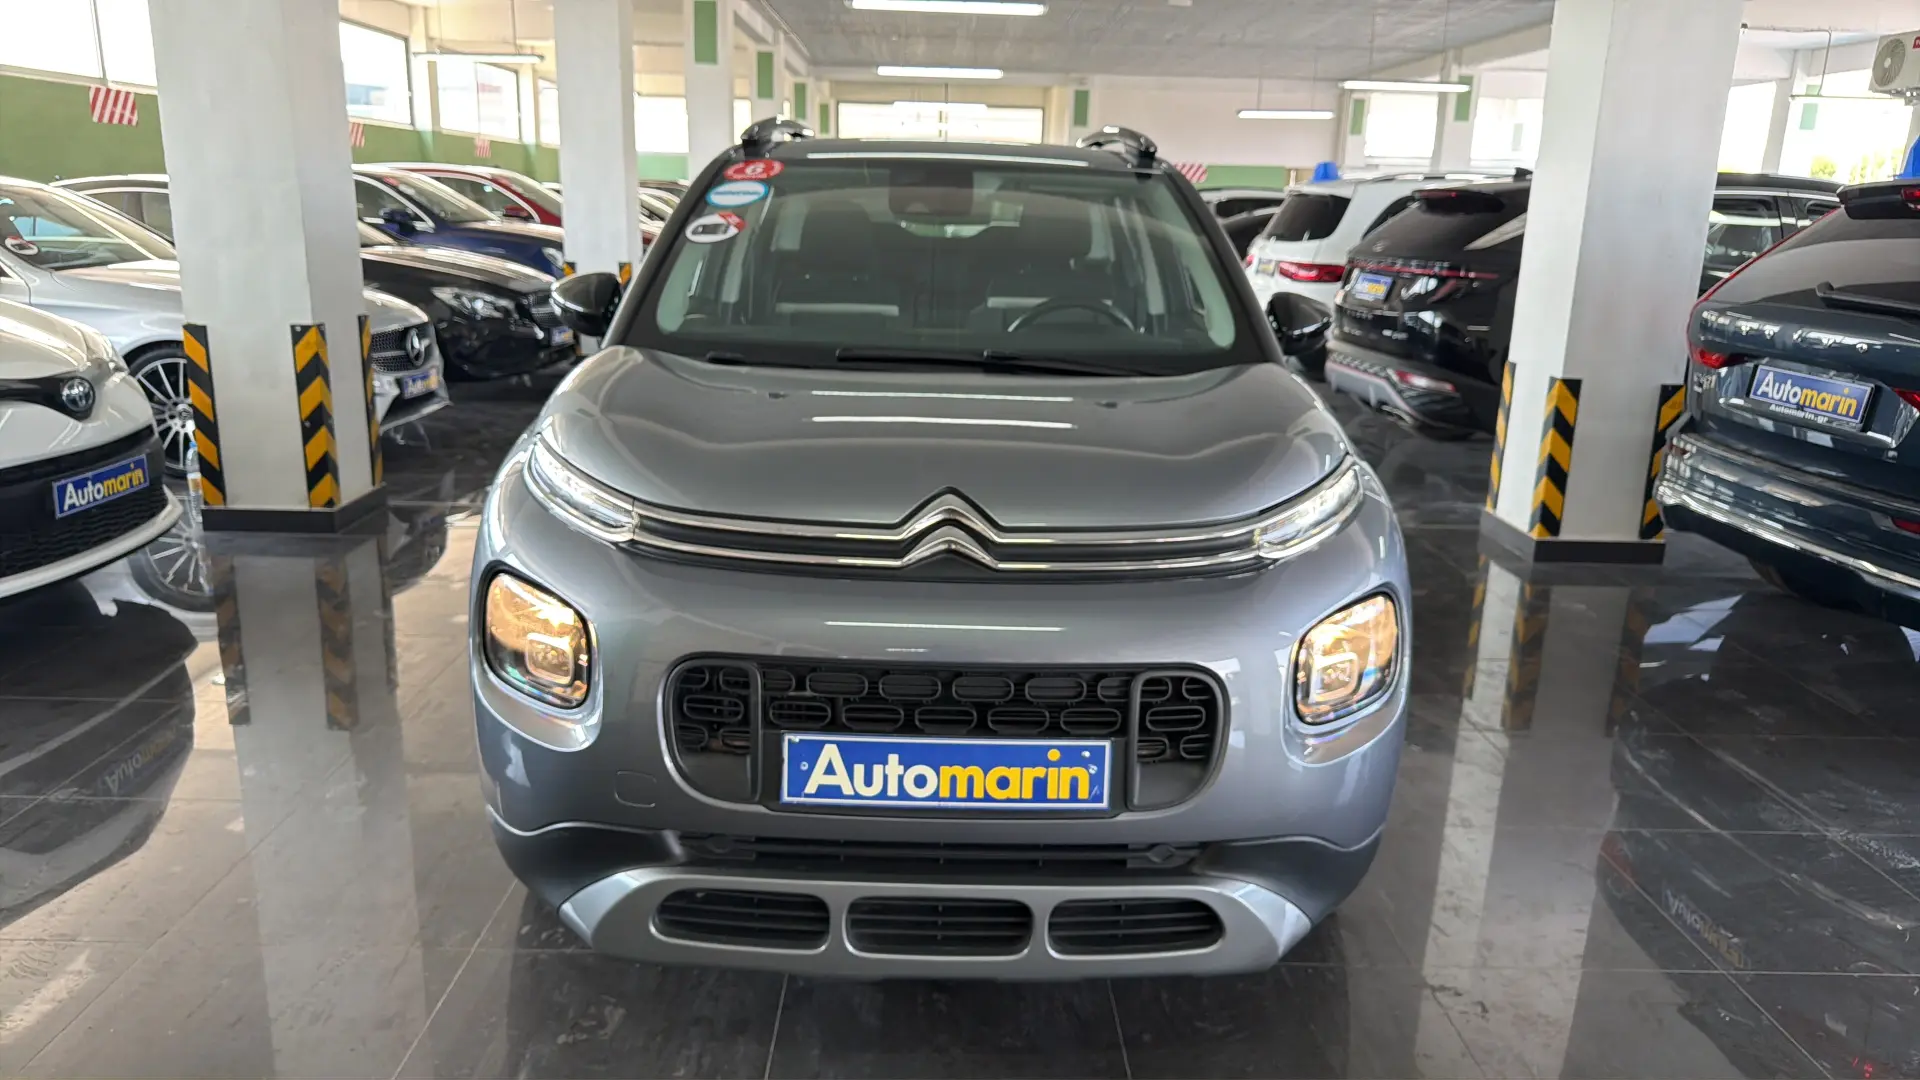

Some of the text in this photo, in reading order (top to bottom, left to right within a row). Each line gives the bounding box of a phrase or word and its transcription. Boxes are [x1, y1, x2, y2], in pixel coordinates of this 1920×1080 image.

[1757, 371, 1857, 417] Automarin
[63, 463, 145, 511] Automarin
[803, 743, 1090, 800] Automarin
